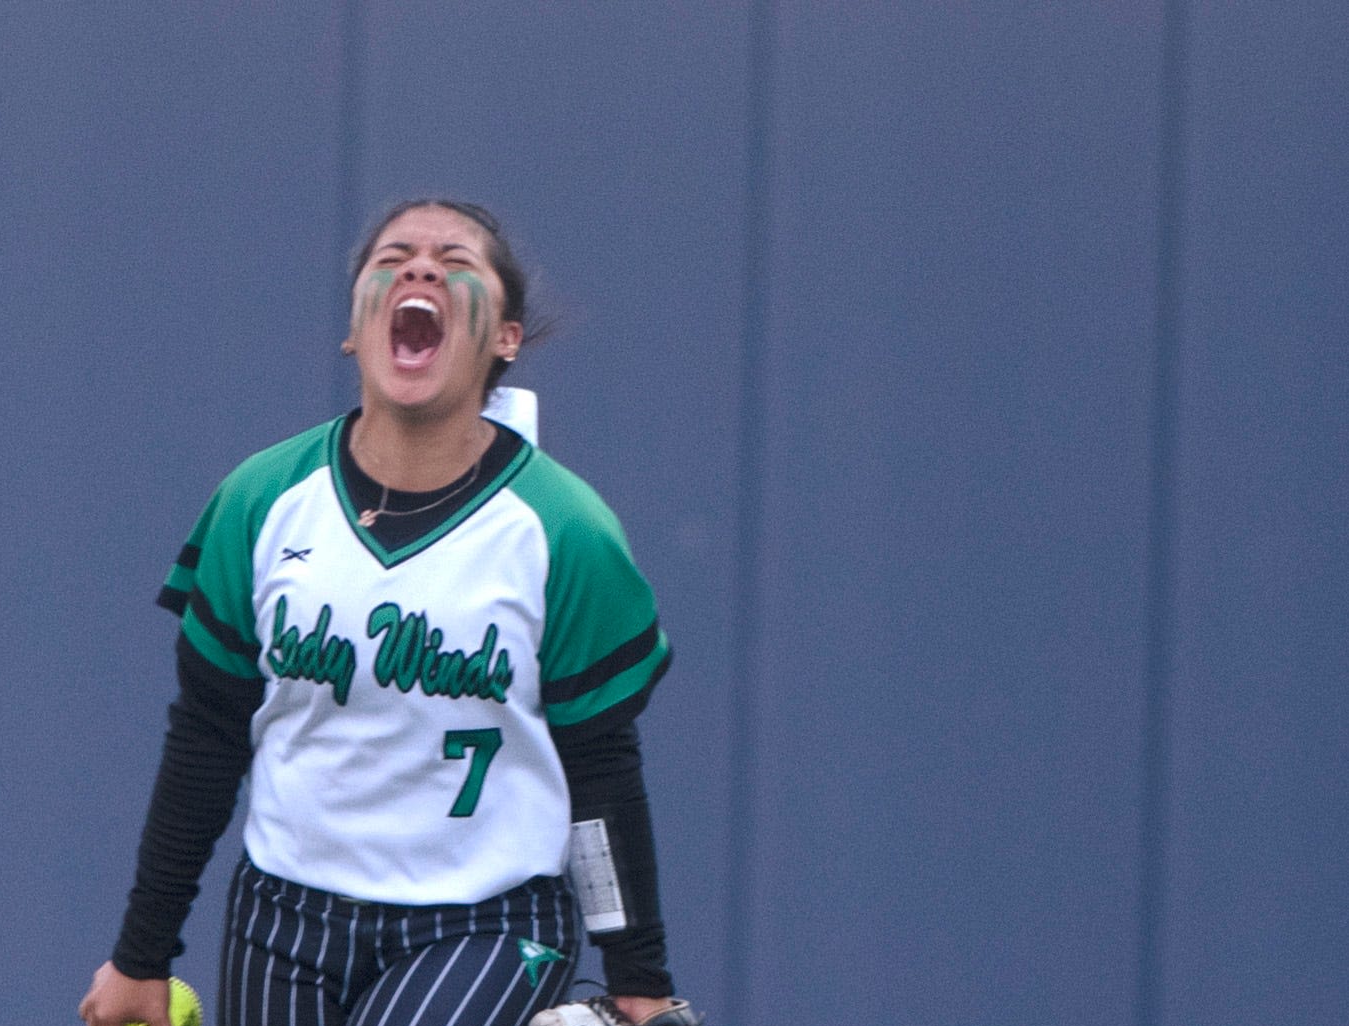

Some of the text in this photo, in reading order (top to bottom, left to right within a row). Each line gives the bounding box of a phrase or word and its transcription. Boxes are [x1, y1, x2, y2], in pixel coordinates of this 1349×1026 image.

[268, 595, 512, 705] Lady Winds
[444, 728, 503, 817] 7
